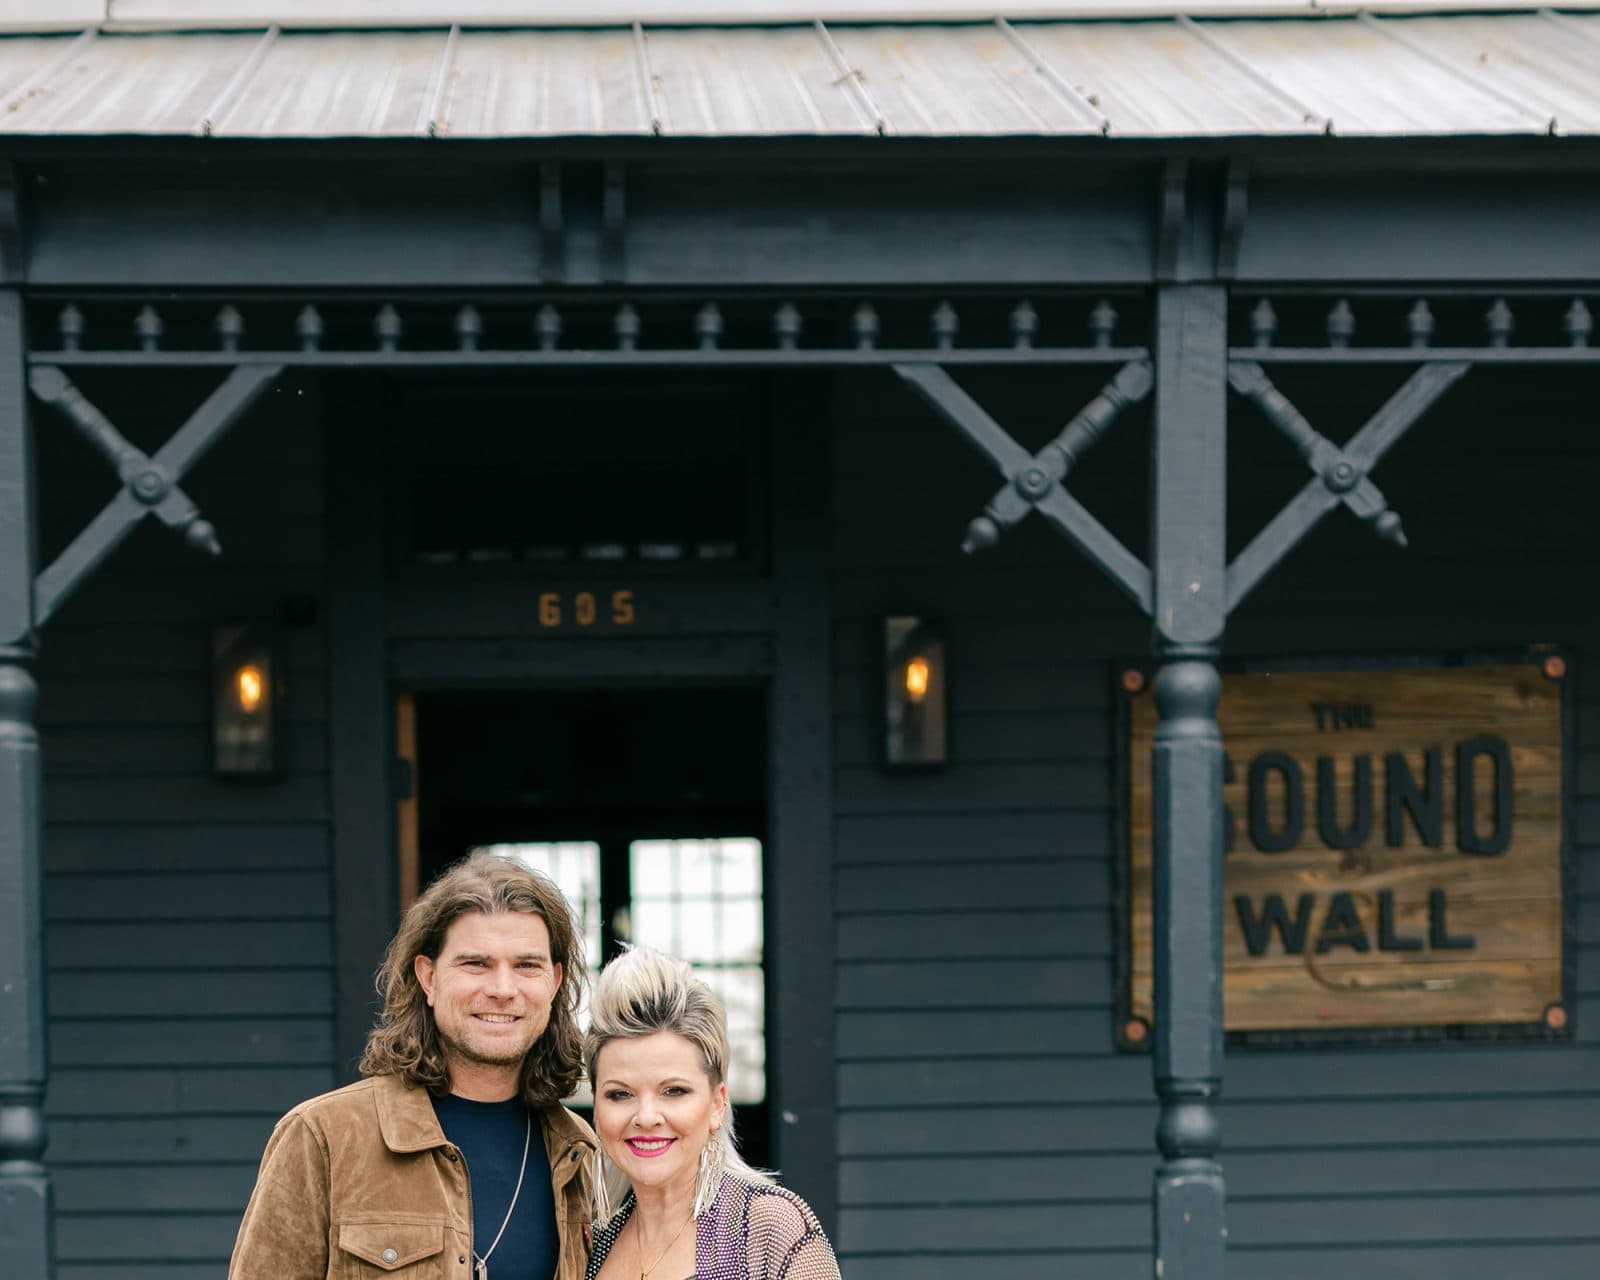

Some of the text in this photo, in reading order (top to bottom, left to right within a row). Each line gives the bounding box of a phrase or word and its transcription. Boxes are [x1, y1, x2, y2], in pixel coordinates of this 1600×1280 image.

[539, 591, 635, 626] 605
[1312, 703, 1375, 731] THE
[1233, 887, 1476, 957] WALL
